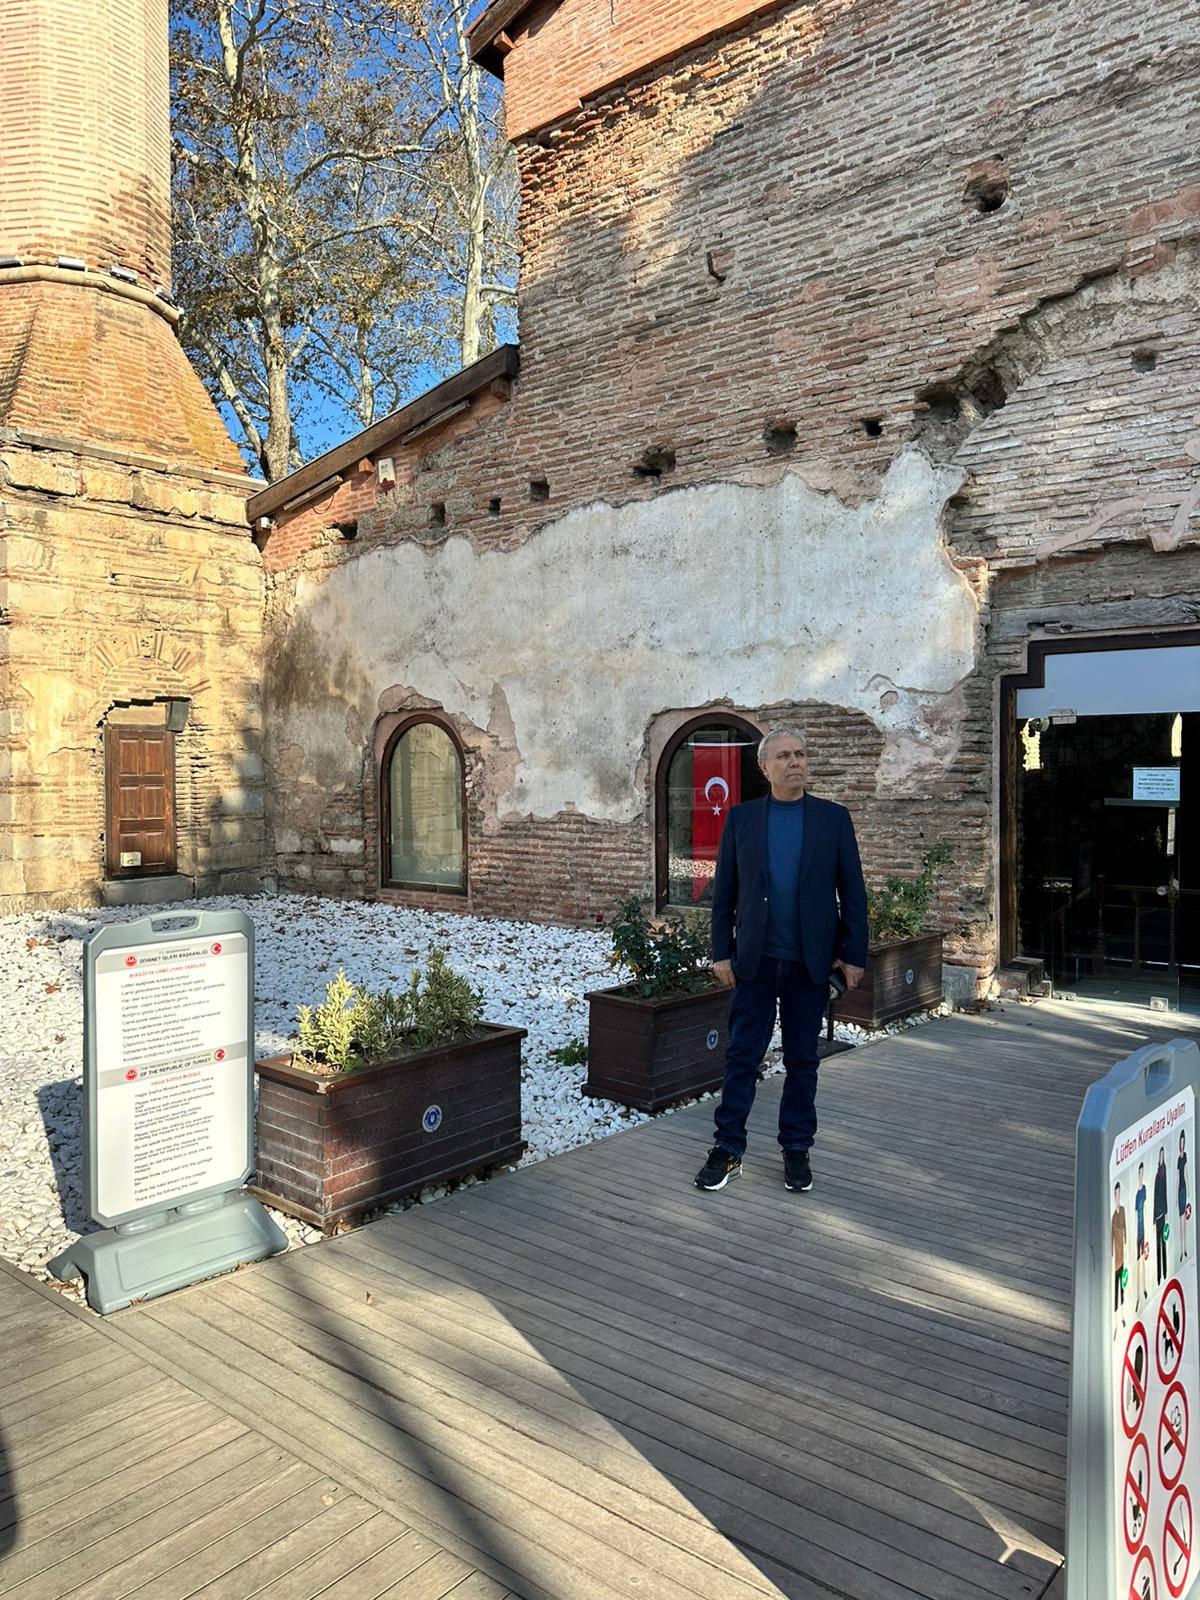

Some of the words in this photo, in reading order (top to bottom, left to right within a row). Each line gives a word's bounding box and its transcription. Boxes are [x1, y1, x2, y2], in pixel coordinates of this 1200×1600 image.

[159, 1063, 182, 1072] REPUBLIC
[193, 1057, 210, 1065] TURKEY
[1116, 1138, 1137, 1166] Lütfen
[1138, 1117, 1165, 1148] Kurallara
[1166, 1102, 1186, 1127] Uyalım
